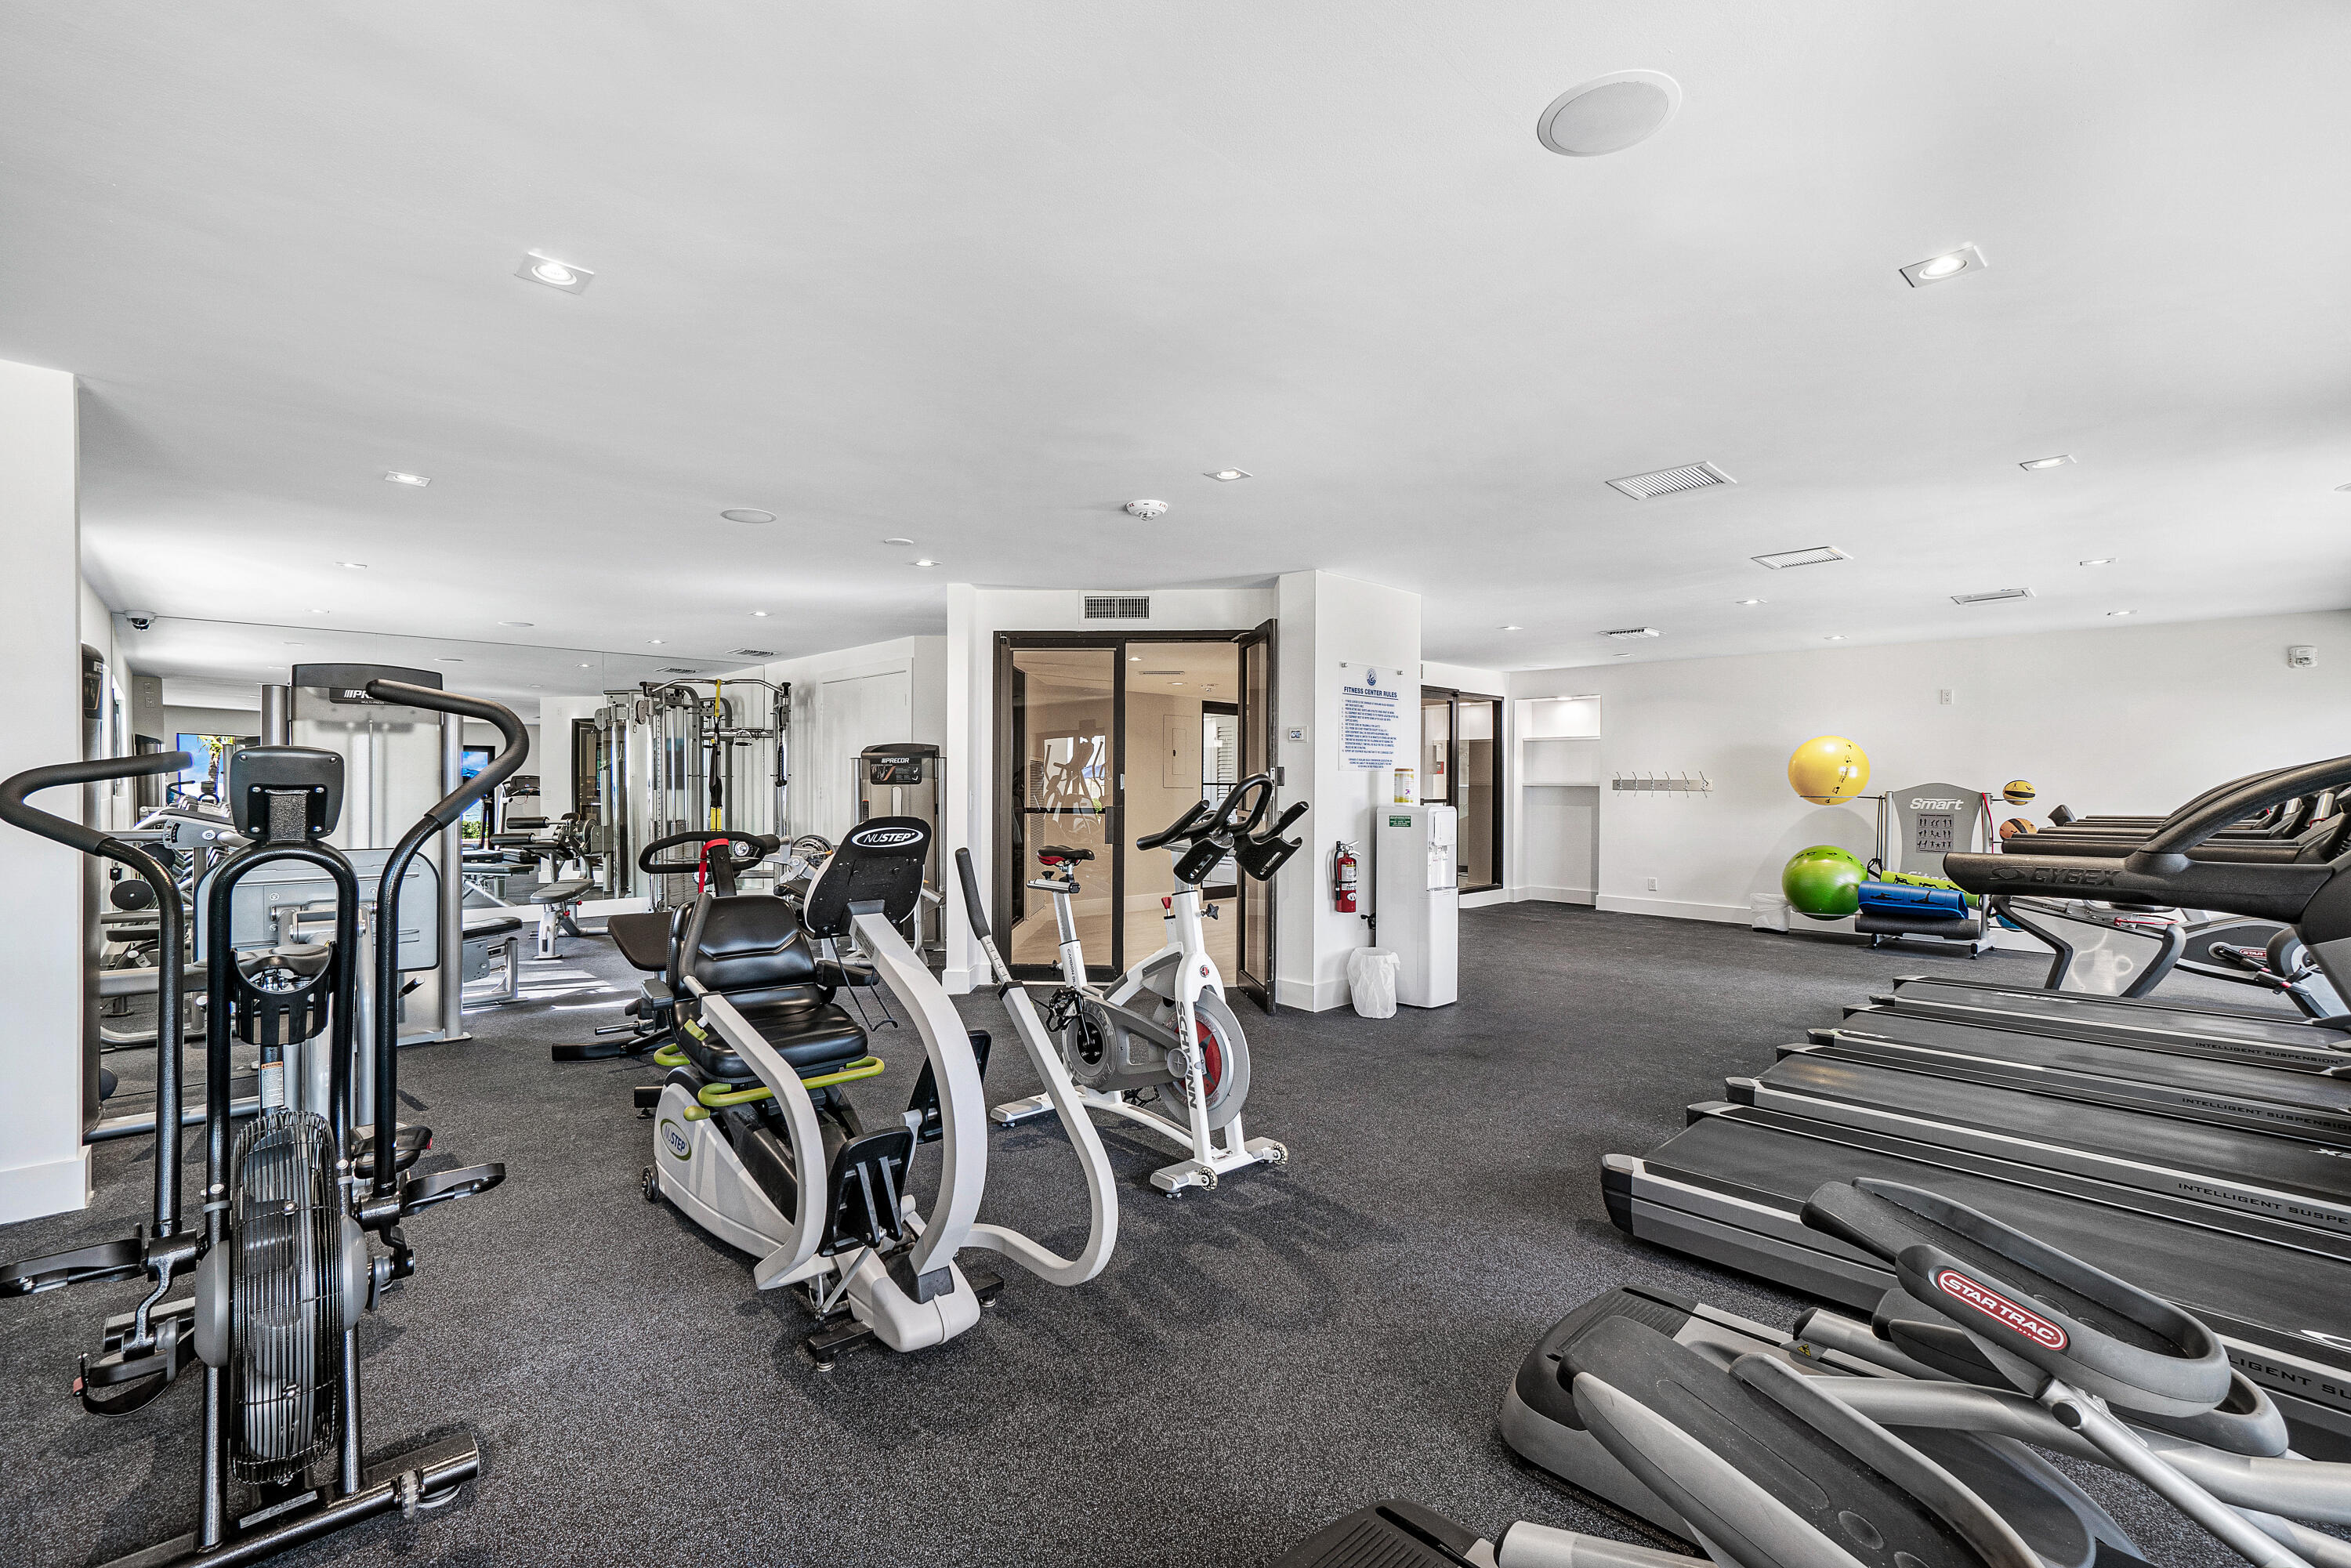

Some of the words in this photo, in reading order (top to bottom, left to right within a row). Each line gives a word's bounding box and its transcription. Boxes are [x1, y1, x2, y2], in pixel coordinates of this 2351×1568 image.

[1364, 688, 1382, 697] CENTER
[1910, 798, 1965, 810] Smart
[864, 833, 911, 843] NUSTEP
[2030, 867, 2123, 886] CYBEX
[2196, 1042, 2262, 1054] INTELLIGENT
[2265, 1051, 2339, 1064] SUSPENSION
[2182, 1097, 2262, 1115] INTELLIGENT
[664, 1125, 686, 1153] NUSTEP
[2178, 1182, 2282, 1210] INTELLIGENT
[1948, 1278, 1998, 1309] STAR
[1999, 1305, 2055, 1341] TRAC
[2228, 1354, 2312, 1386] LIGENT
